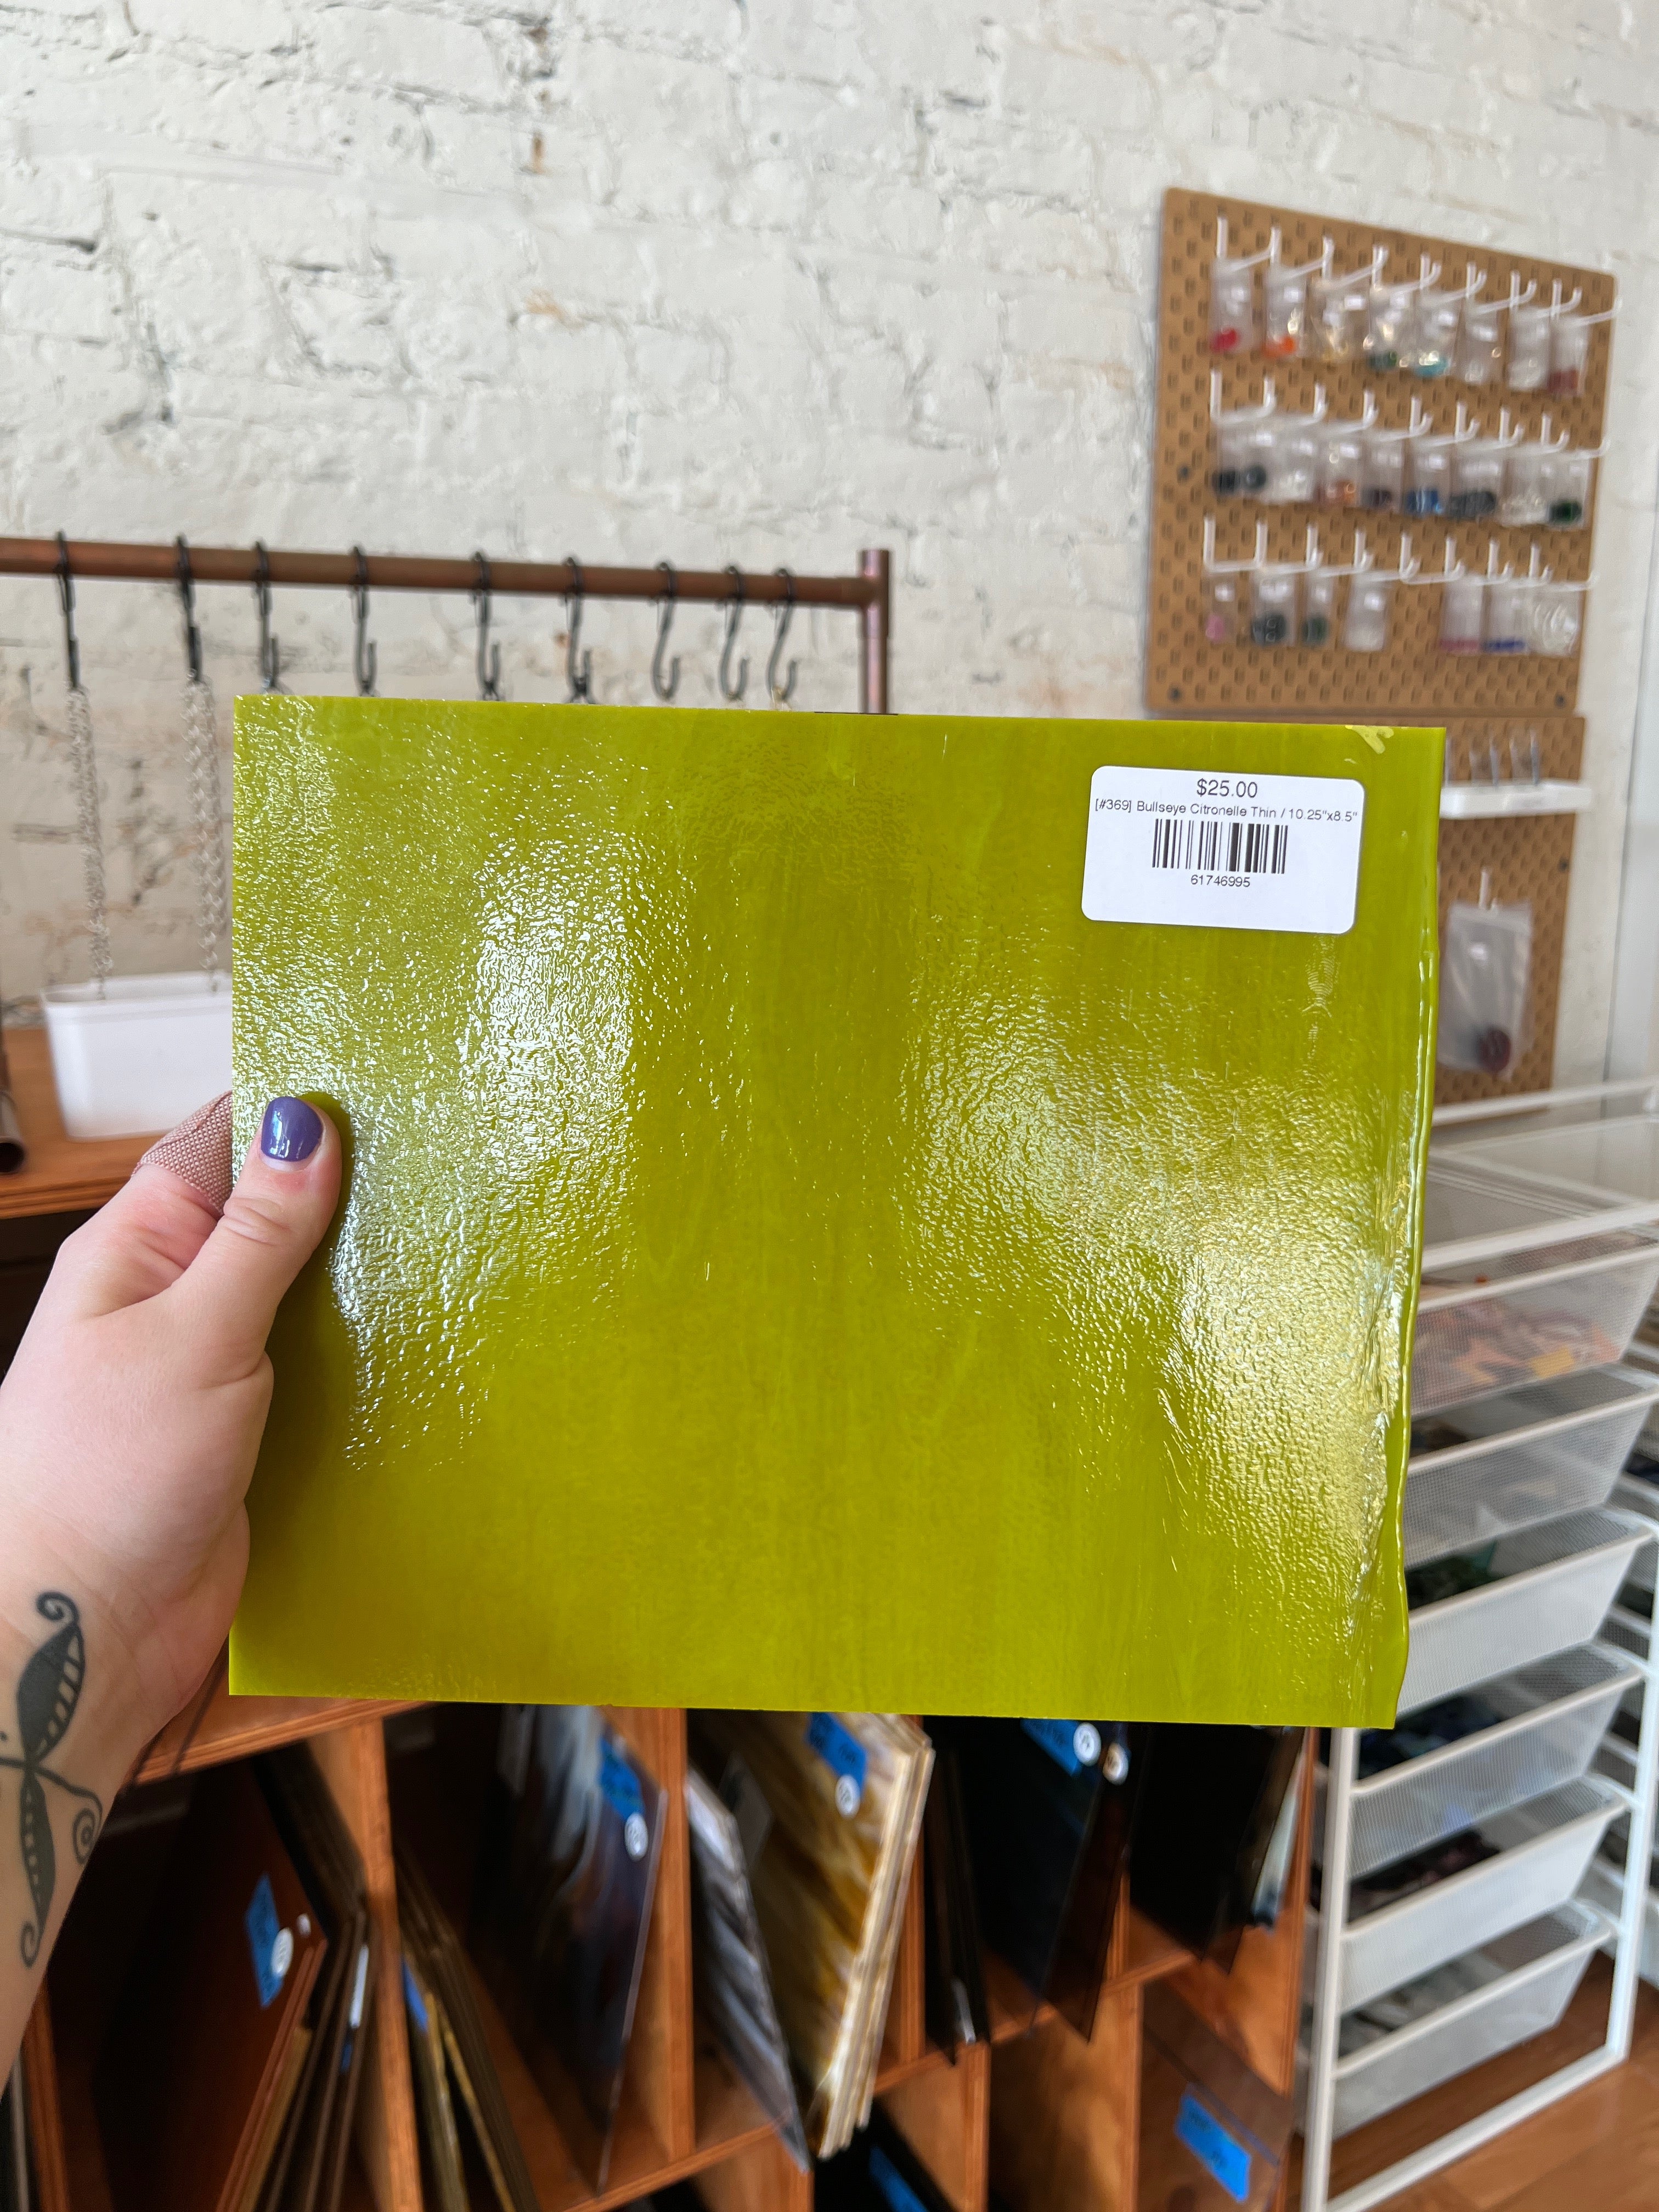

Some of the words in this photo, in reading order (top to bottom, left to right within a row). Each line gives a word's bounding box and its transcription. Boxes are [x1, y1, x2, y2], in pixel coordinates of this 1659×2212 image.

[1196, 777, 1258, 799] $25.00
[1095, 798, 1132, 814] [#369]
[1137, 800, 1186, 816] Bullseye
[1190, 803, 1247, 817] Citronelle
[1250, 806, 1277, 818] Thin
[1280, 808, 1285, 819] /
[1289, 809, 1358, 822] 10.25"x8.5"
[1190, 874, 1250, 888] 61746995
